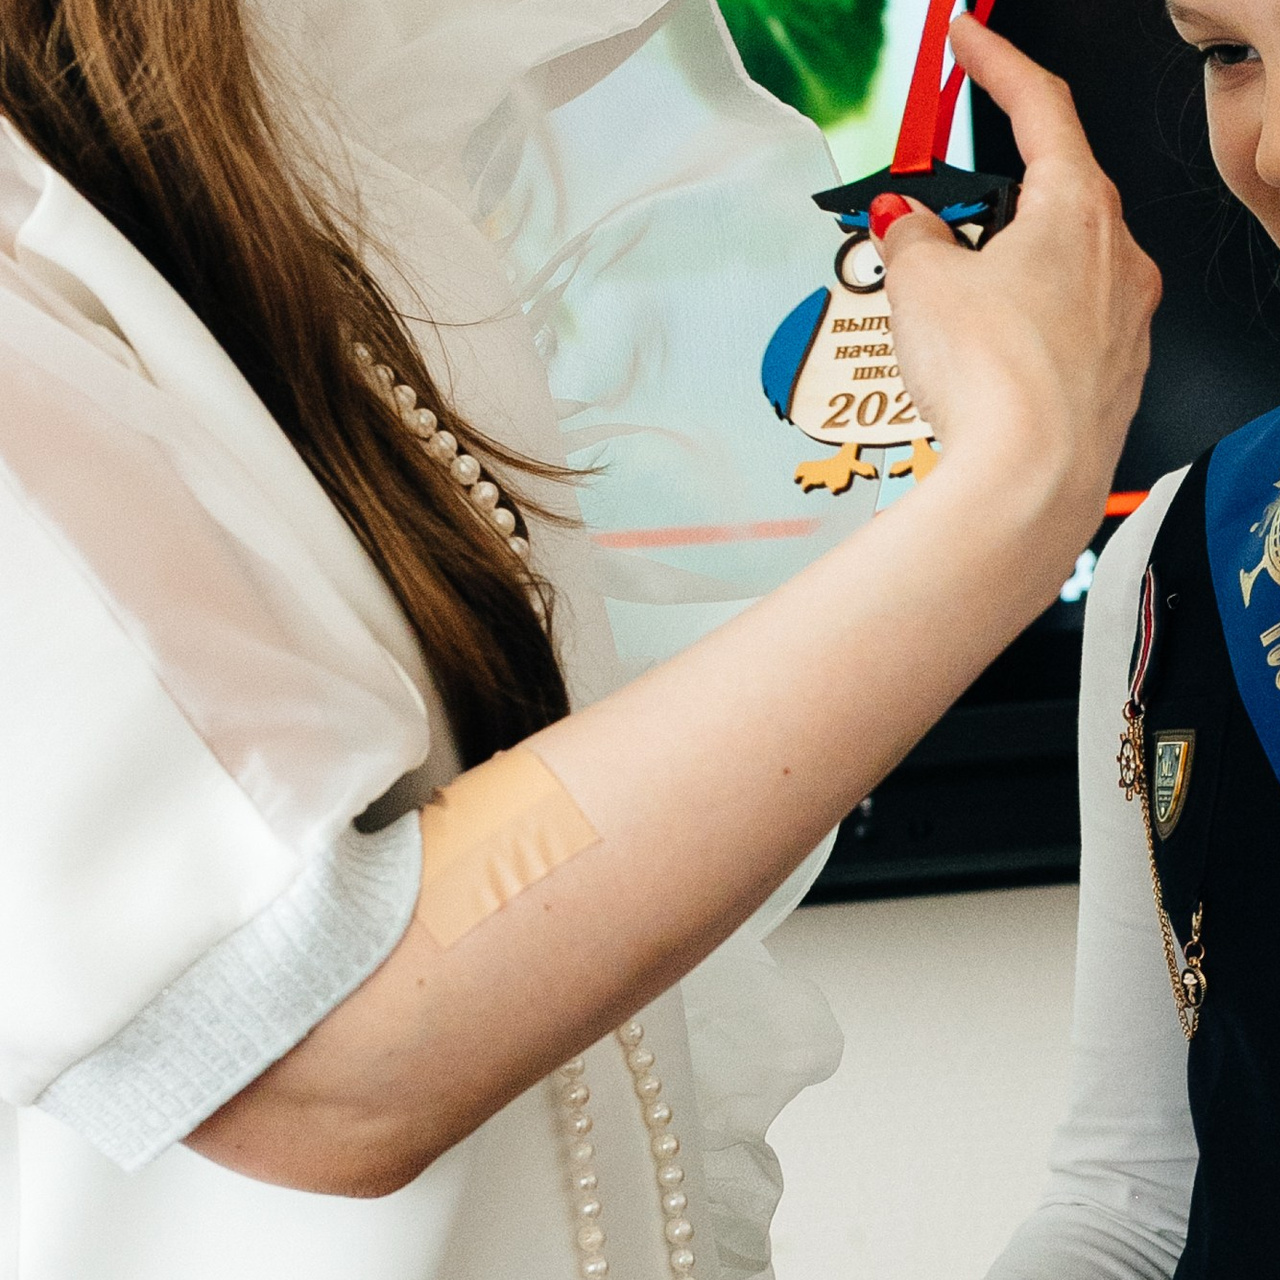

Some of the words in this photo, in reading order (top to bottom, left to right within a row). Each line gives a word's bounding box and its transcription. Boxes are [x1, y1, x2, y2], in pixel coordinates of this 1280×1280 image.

[831, 316, 891, 335] выпу
[834, 343, 894, 360] нача
[852, 365, 900, 380] шко
[821, 390, 917, 428] 202
